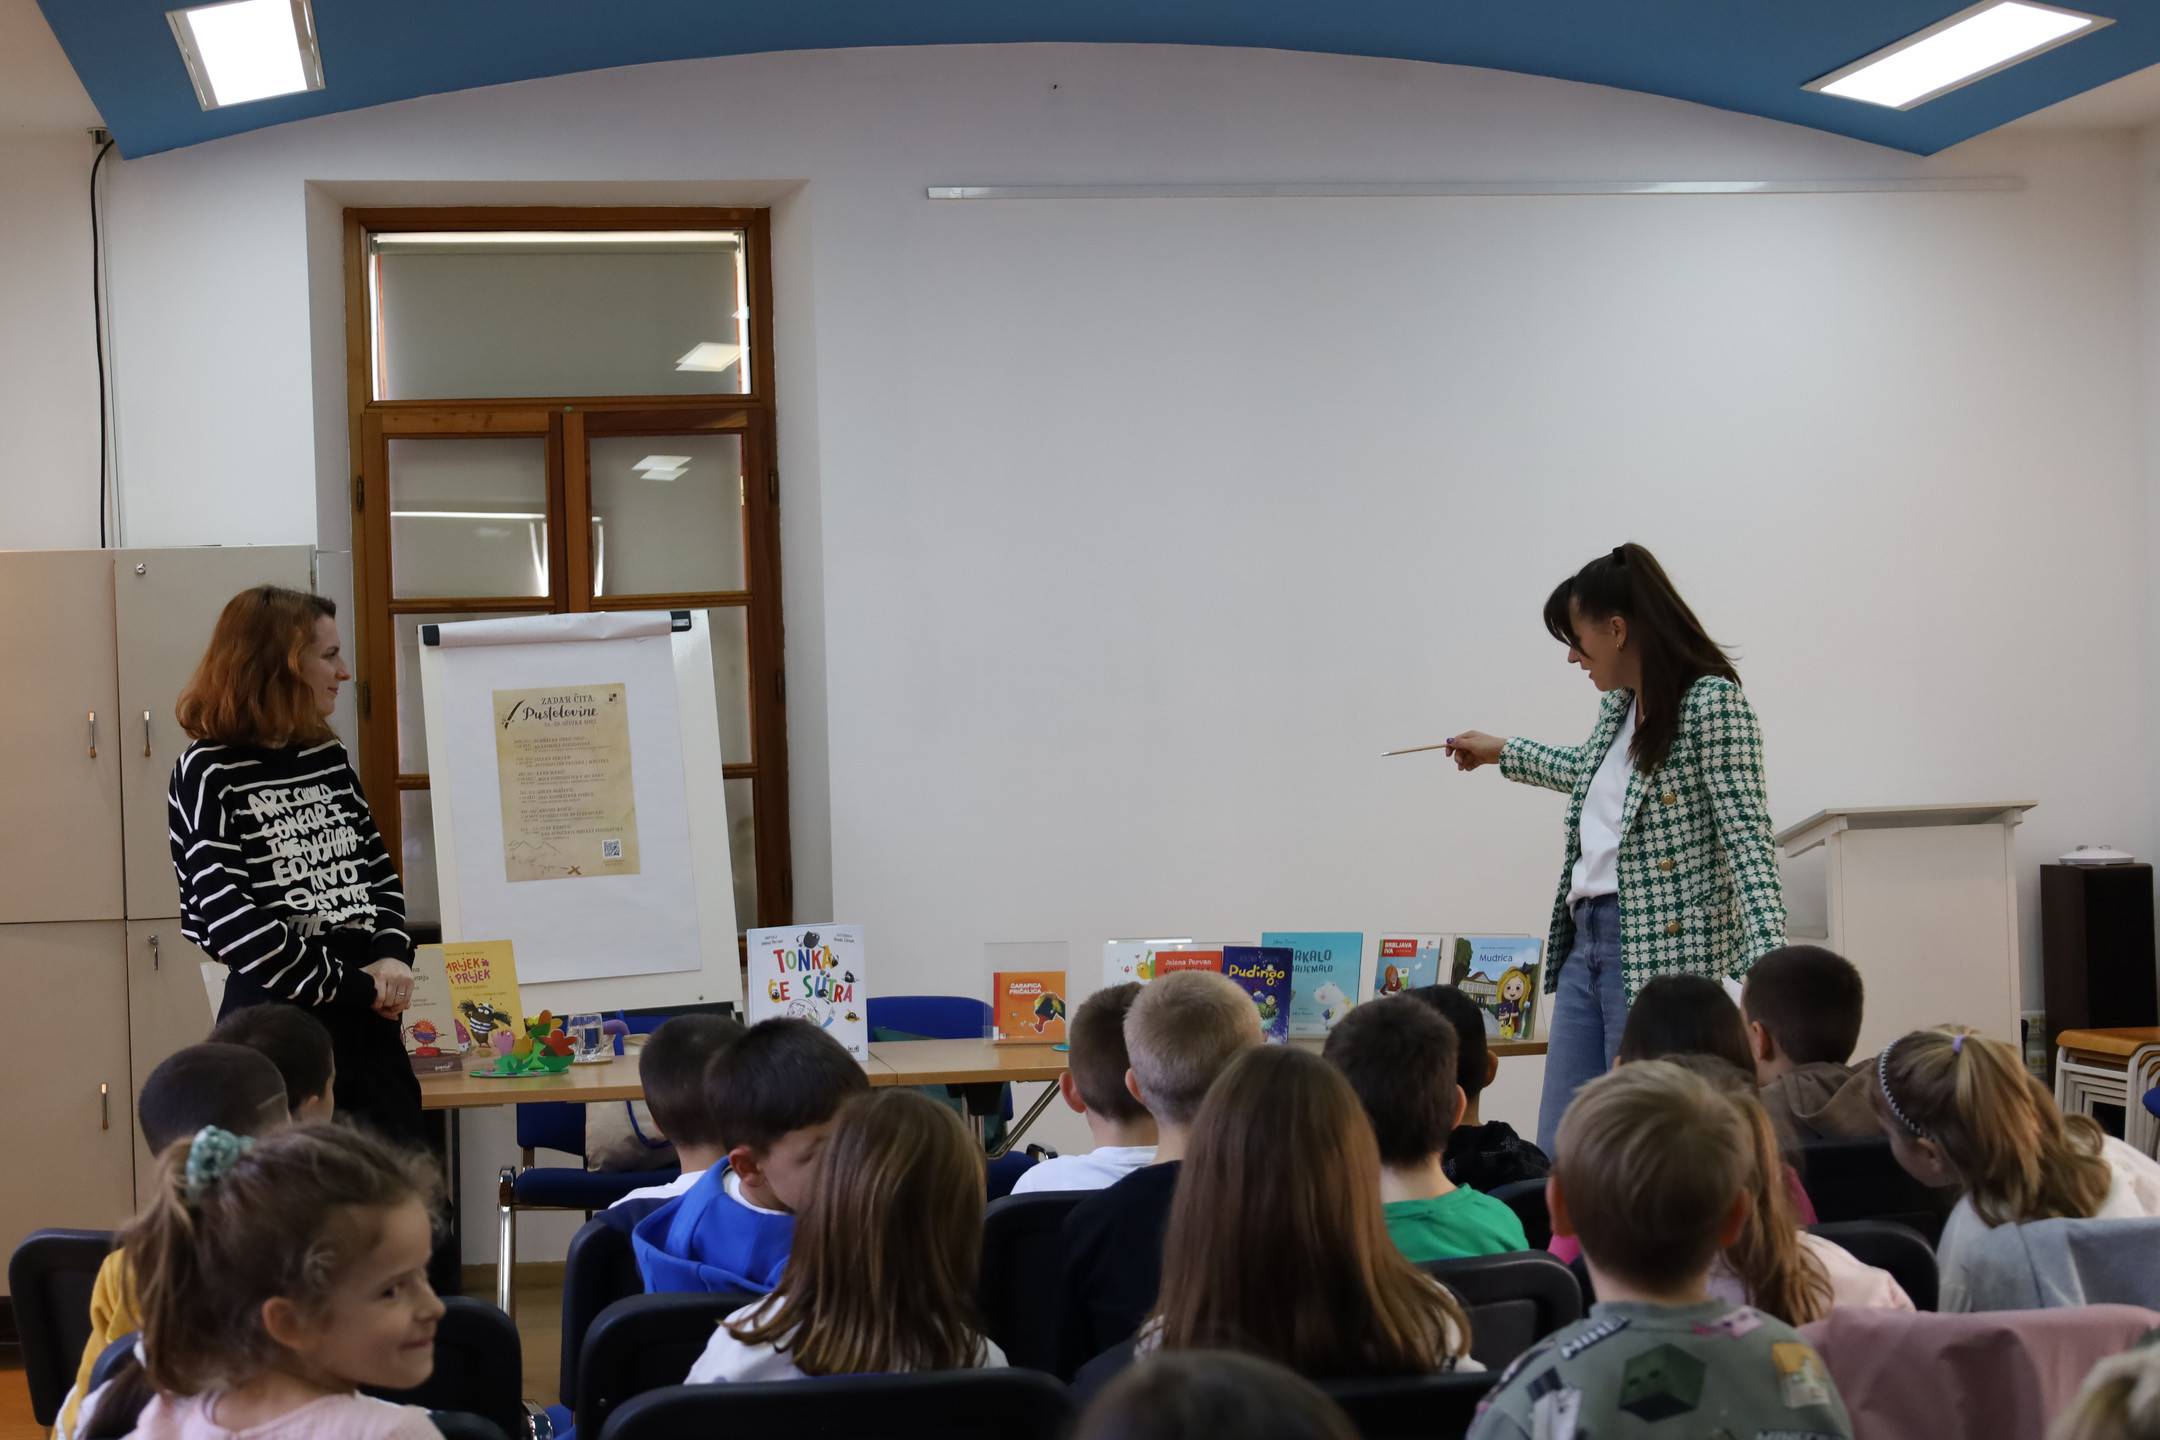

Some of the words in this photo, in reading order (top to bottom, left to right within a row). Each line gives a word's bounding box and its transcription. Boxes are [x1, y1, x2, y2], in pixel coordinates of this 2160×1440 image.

[541, 696, 571, 705] ZADAR
[523, 705, 598, 721] Pustolovine
[248, 788, 293, 823] ART
[262, 803, 346, 838] COMFORT
[773, 944, 833, 973] TONKA
[1295, 950, 1332, 963] RKALO
[1480, 953, 1513, 962] Mudrica
[455, 969, 491, 984] PRLJEK
[1229, 964, 1285, 986] Pudingo
